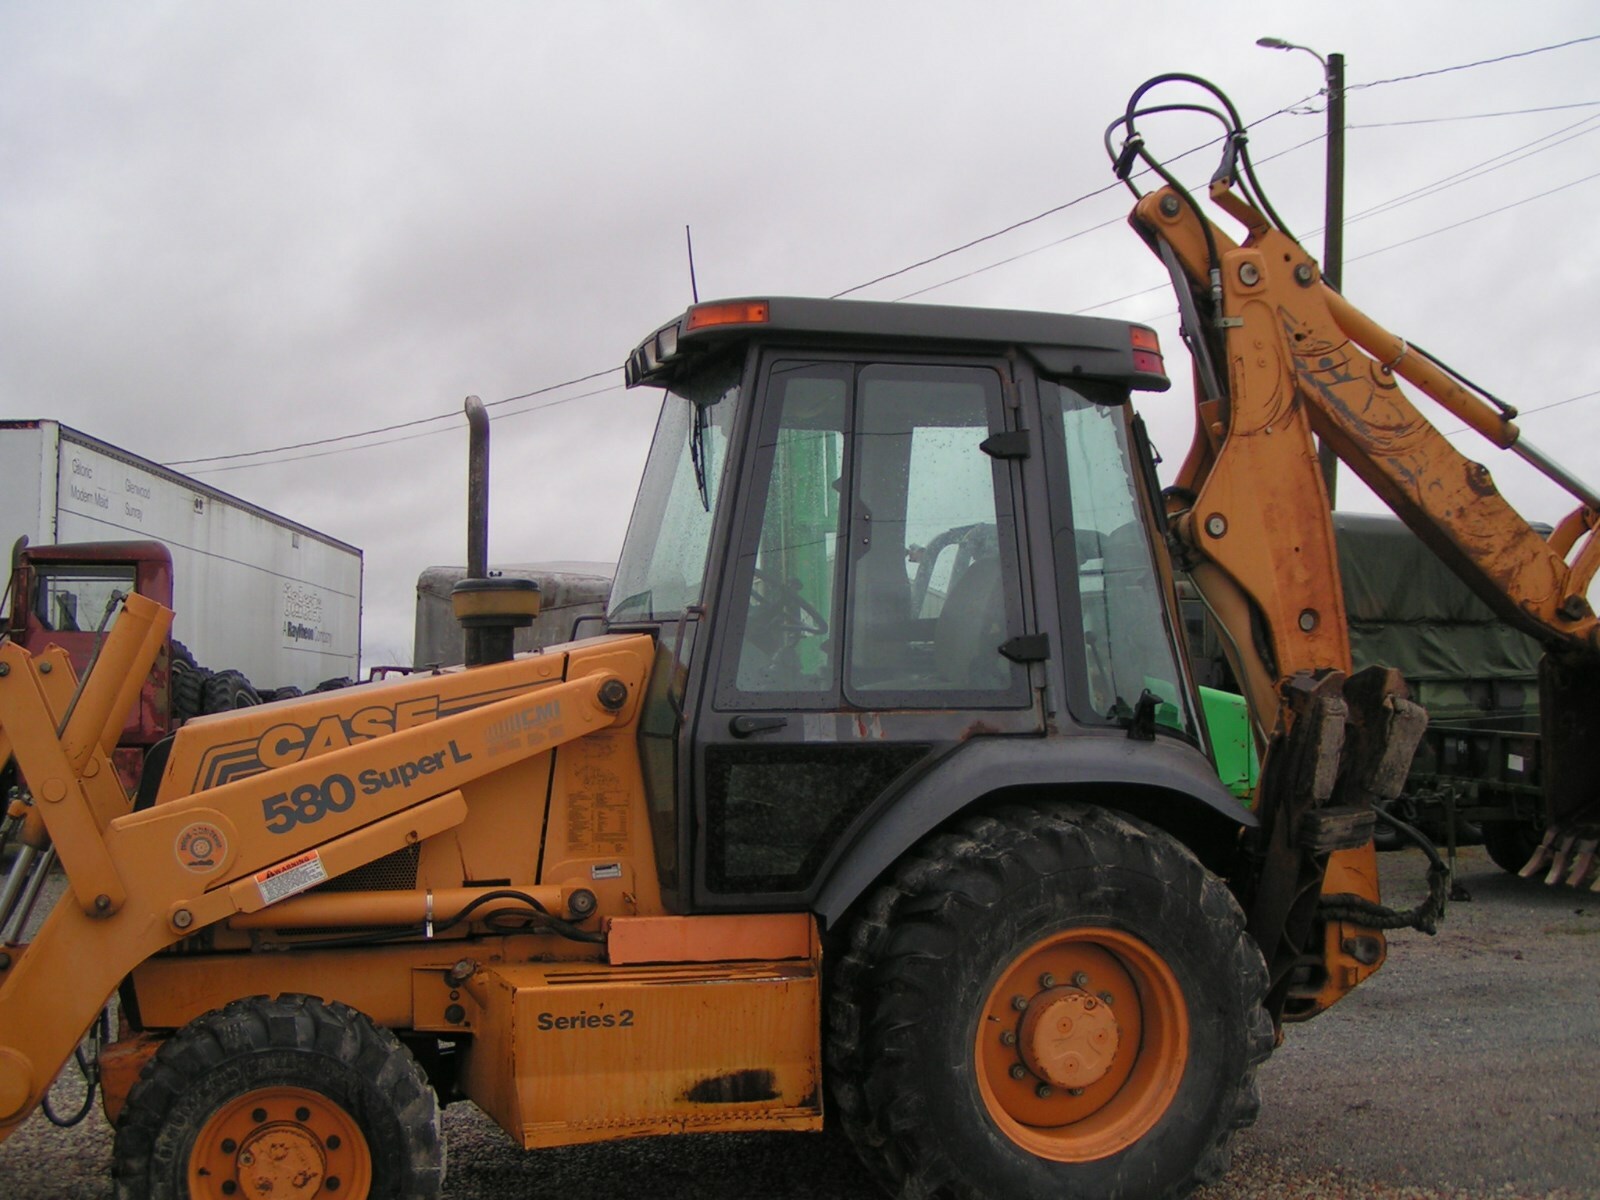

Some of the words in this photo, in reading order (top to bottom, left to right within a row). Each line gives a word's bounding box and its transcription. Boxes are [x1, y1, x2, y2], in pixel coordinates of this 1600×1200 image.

[71, 484, 93, 503] Modern
[94, 491, 109, 510] Maid
[125, 478, 151, 500] Glenwood
[125, 501, 143, 523] Sunray
[288, 621, 314, 643] Raytheon
[256, 695, 440, 770] CASE
[262, 773, 356, 834] 580
[358, 748, 447, 796] Super
[448, 739, 473, 764] L
[273, 855, 310, 875] WARNING
[537, 1009, 616, 1031] Series
[619, 1009, 634, 1028] 2
